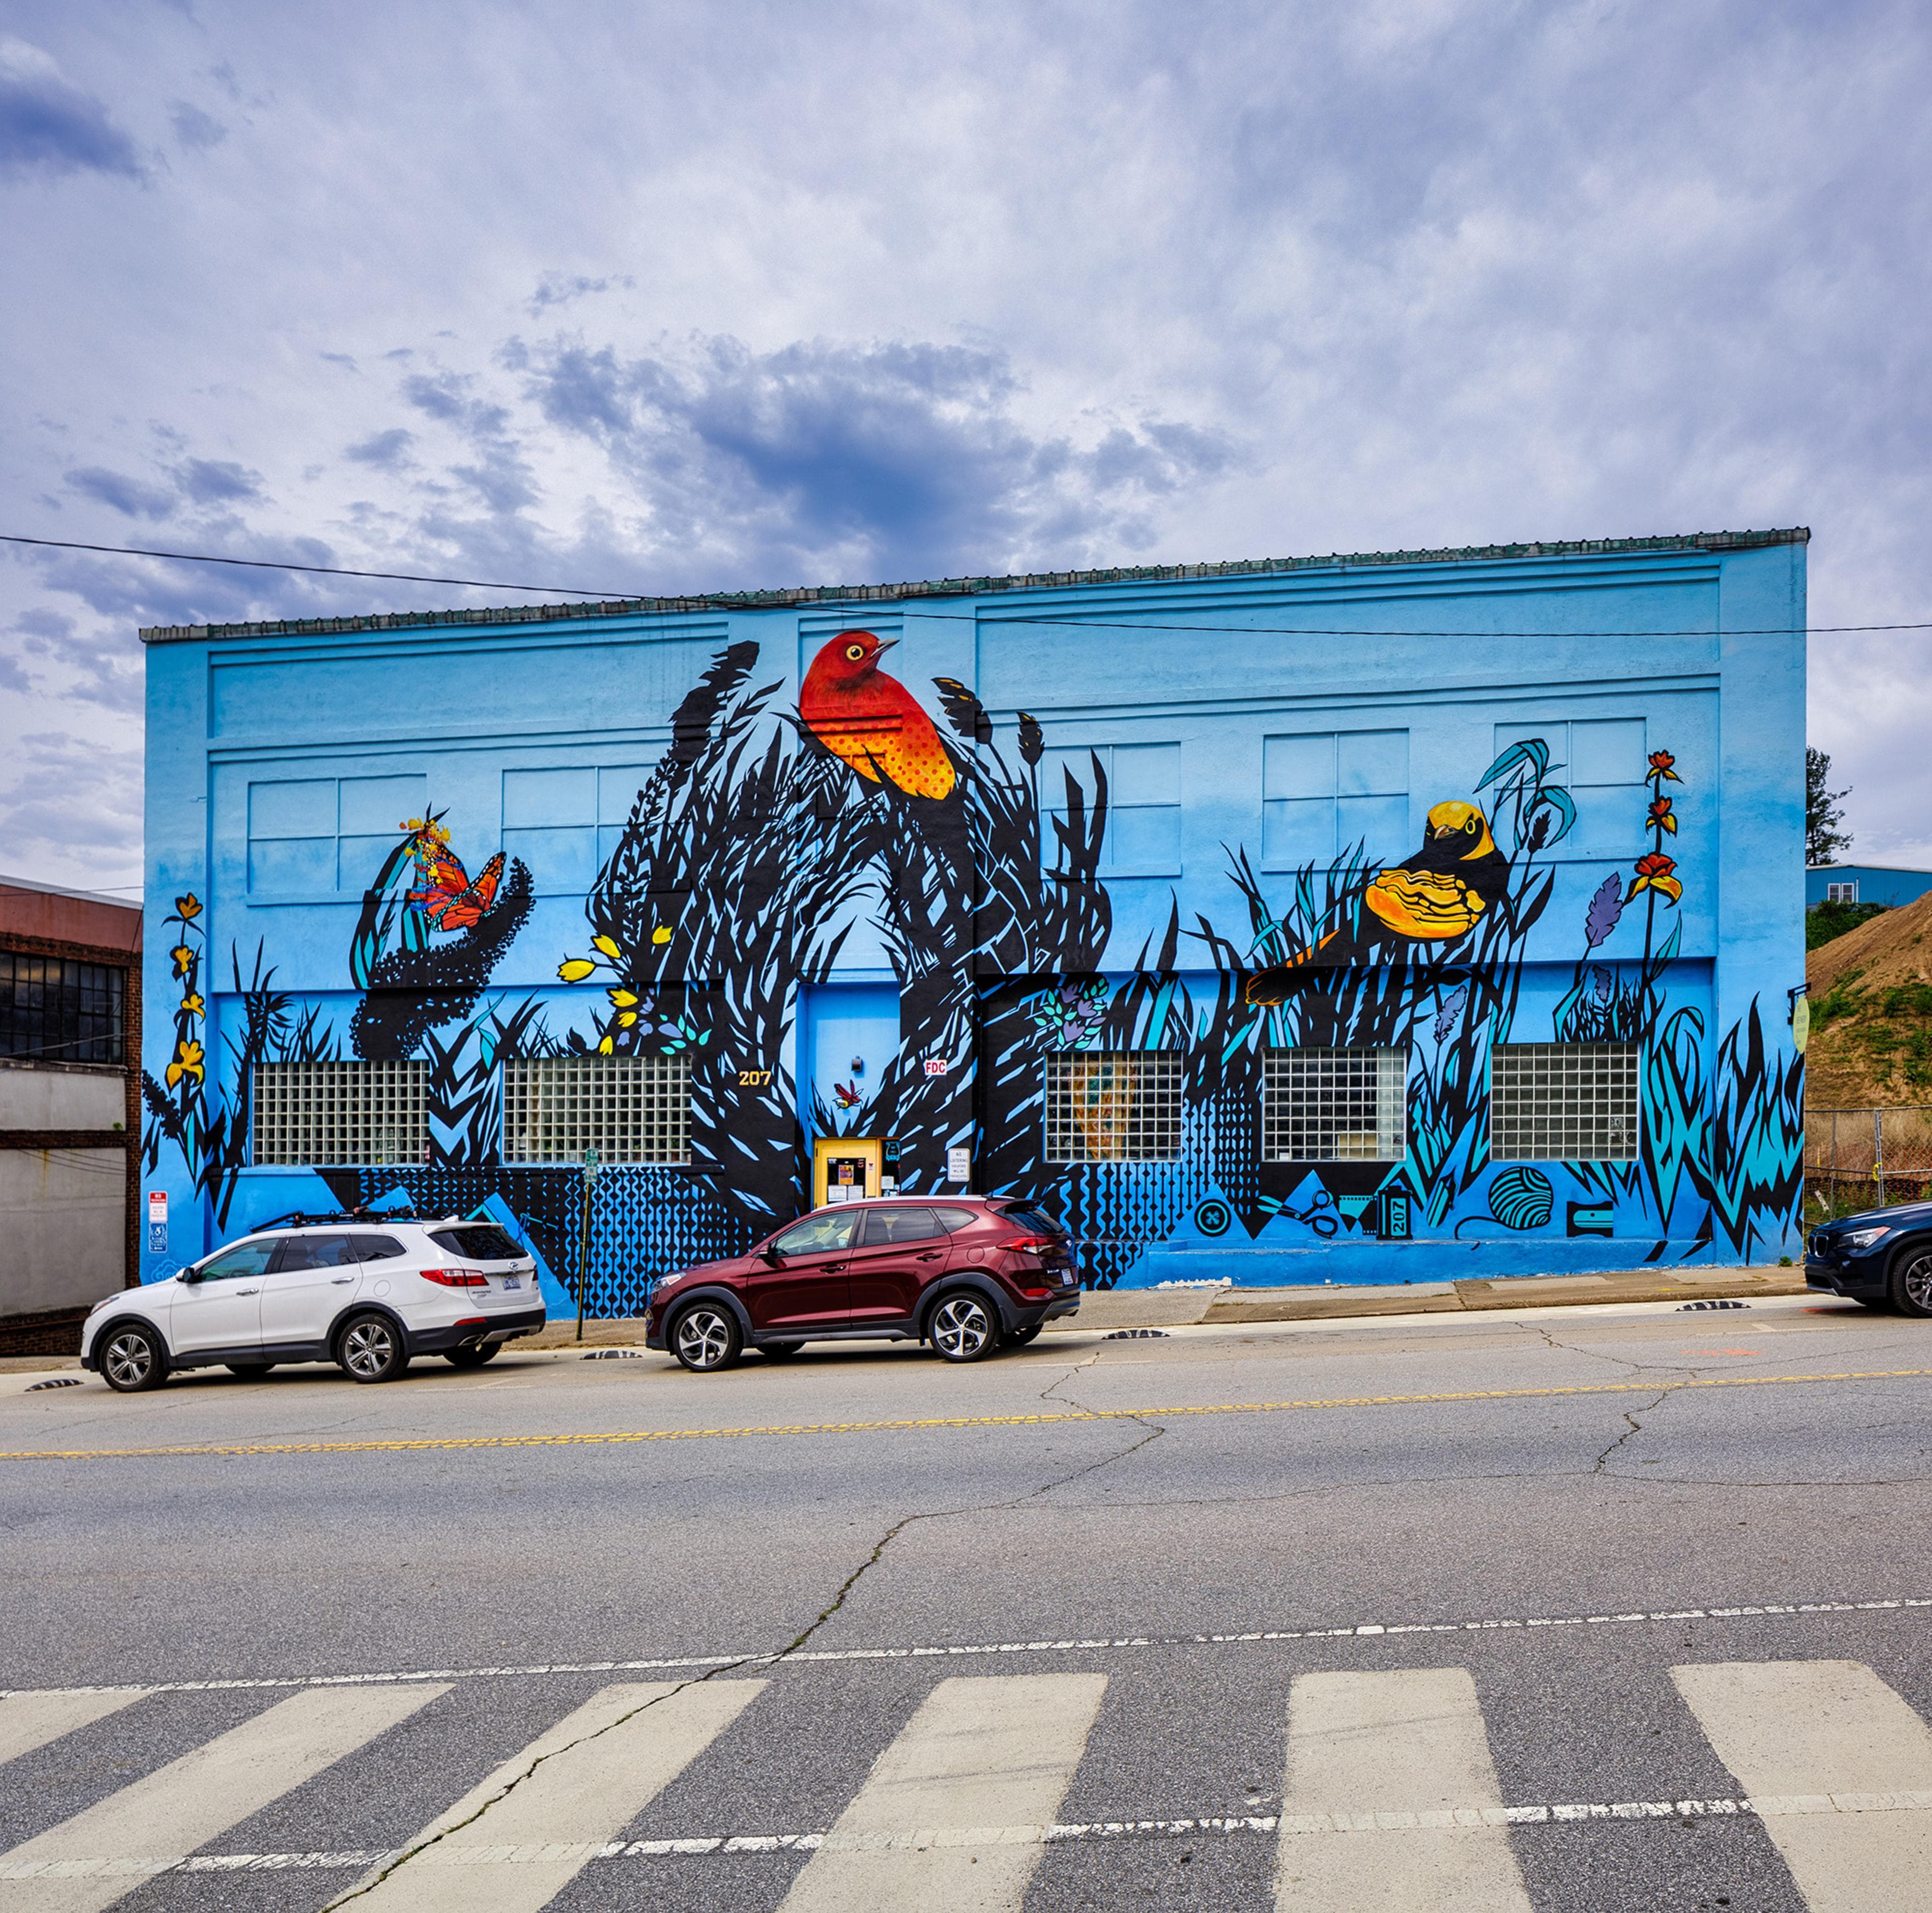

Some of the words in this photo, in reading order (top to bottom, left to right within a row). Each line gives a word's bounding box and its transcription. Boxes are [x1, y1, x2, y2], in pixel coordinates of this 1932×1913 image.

[926, 1062, 945, 1073] FDC
[739, 1071, 771, 1085] 207
[1393, 1201, 1405, 1232] 207
